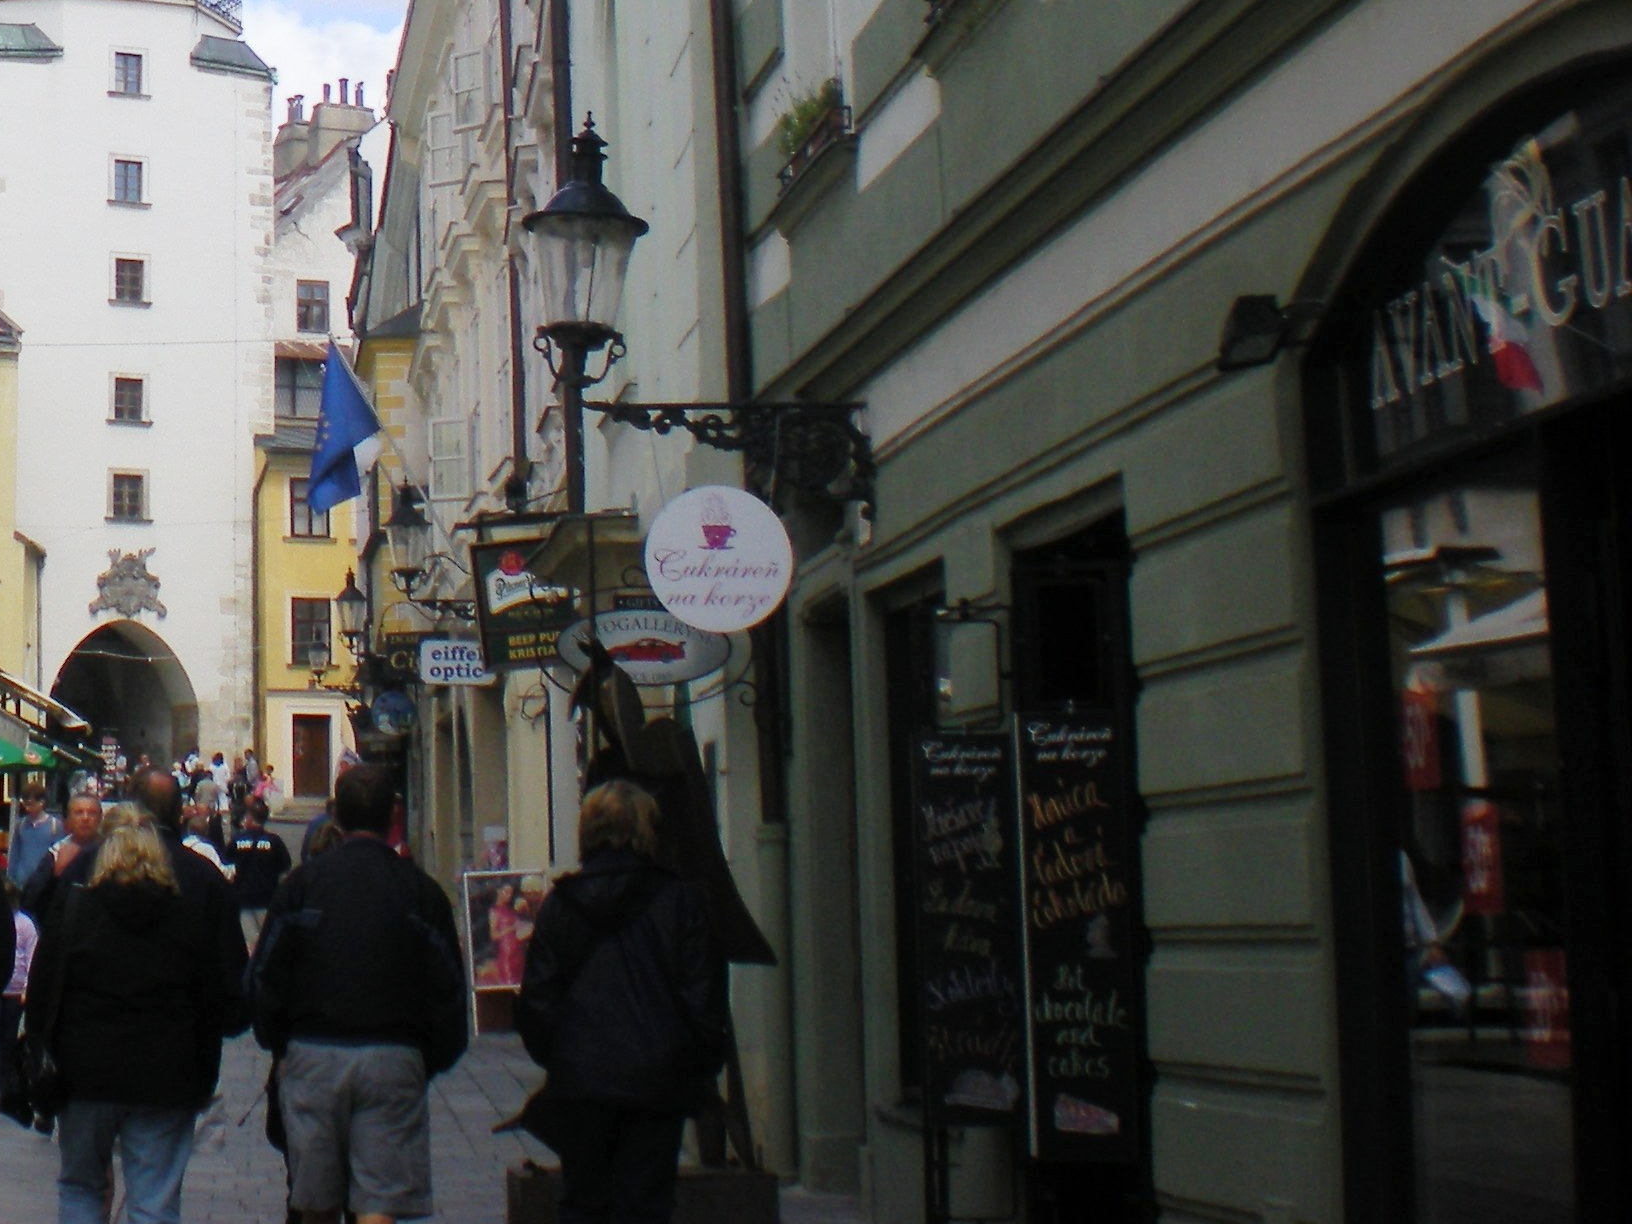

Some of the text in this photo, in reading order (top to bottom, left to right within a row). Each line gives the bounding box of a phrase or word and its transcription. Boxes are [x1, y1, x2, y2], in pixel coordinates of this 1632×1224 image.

[654, 549, 780, 581] Cukráreň
[666, 593, 696, 606] na
[431, 645, 483, 661] eiffel
[509, 645, 557, 659] KRISTIA
[430, 663, 483, 681] optic
